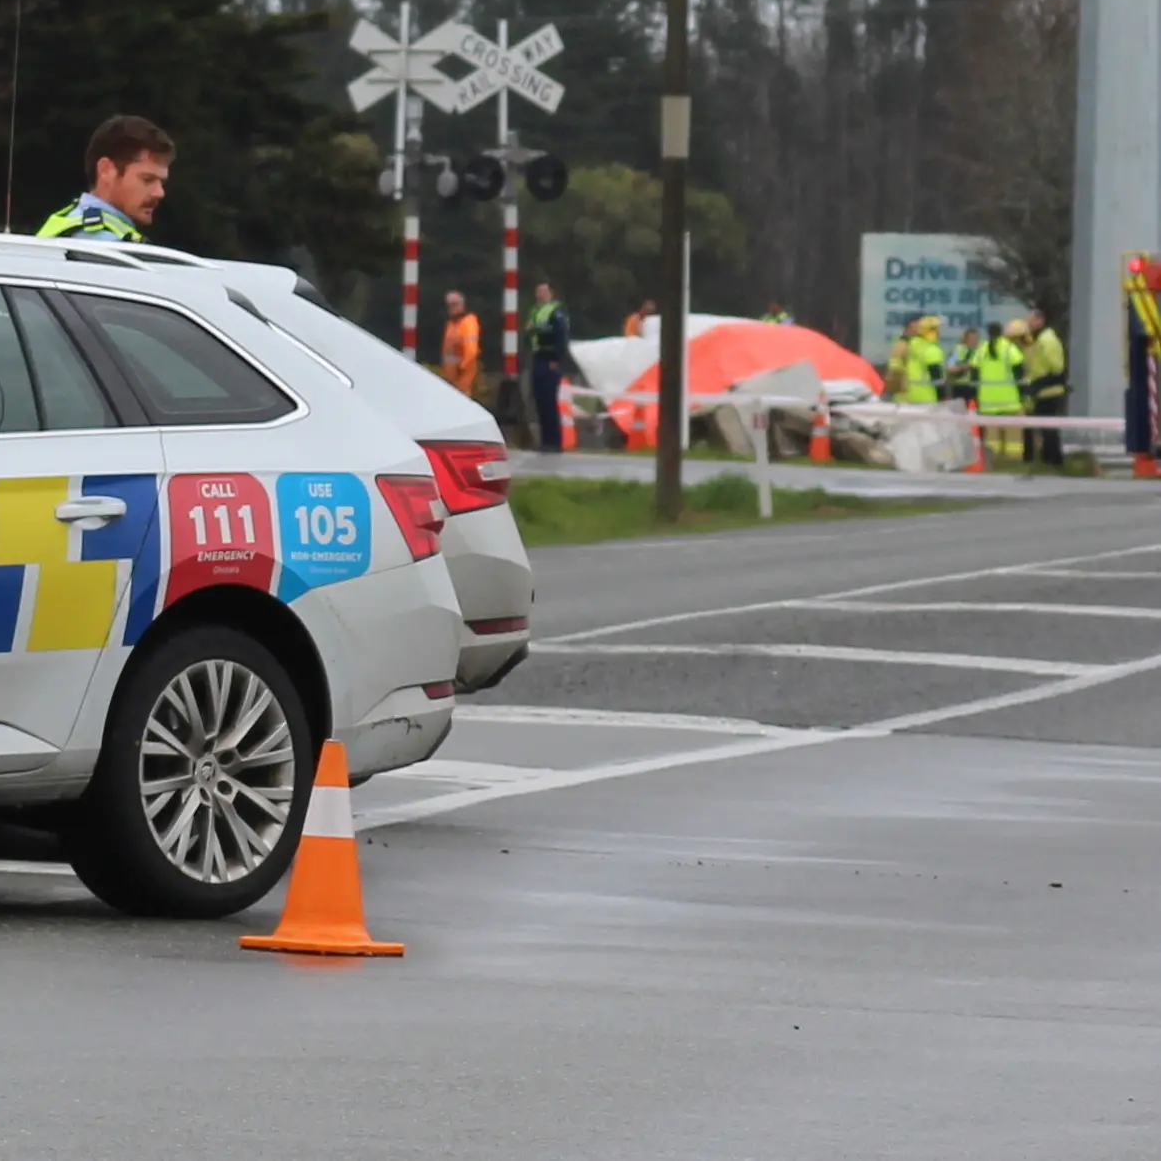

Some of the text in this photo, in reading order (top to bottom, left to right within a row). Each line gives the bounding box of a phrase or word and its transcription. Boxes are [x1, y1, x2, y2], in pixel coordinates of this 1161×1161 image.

[458, 32, 556, 104] RAIL WAY
[460, 34, 554, 102] CROSSING
[885, 256, 959, 280] Drive
[884, 286, 951, 308] cops
[200, 483, 236, 498] CALL
[308, 482, 333, 498] USE
[188, 504, 257, 545] 111
[294, 505, 358, 545] 105
[197, 550, 257, 562] EMERGENCY
[290, 550, 363, 562] NON-EMERGENCY
